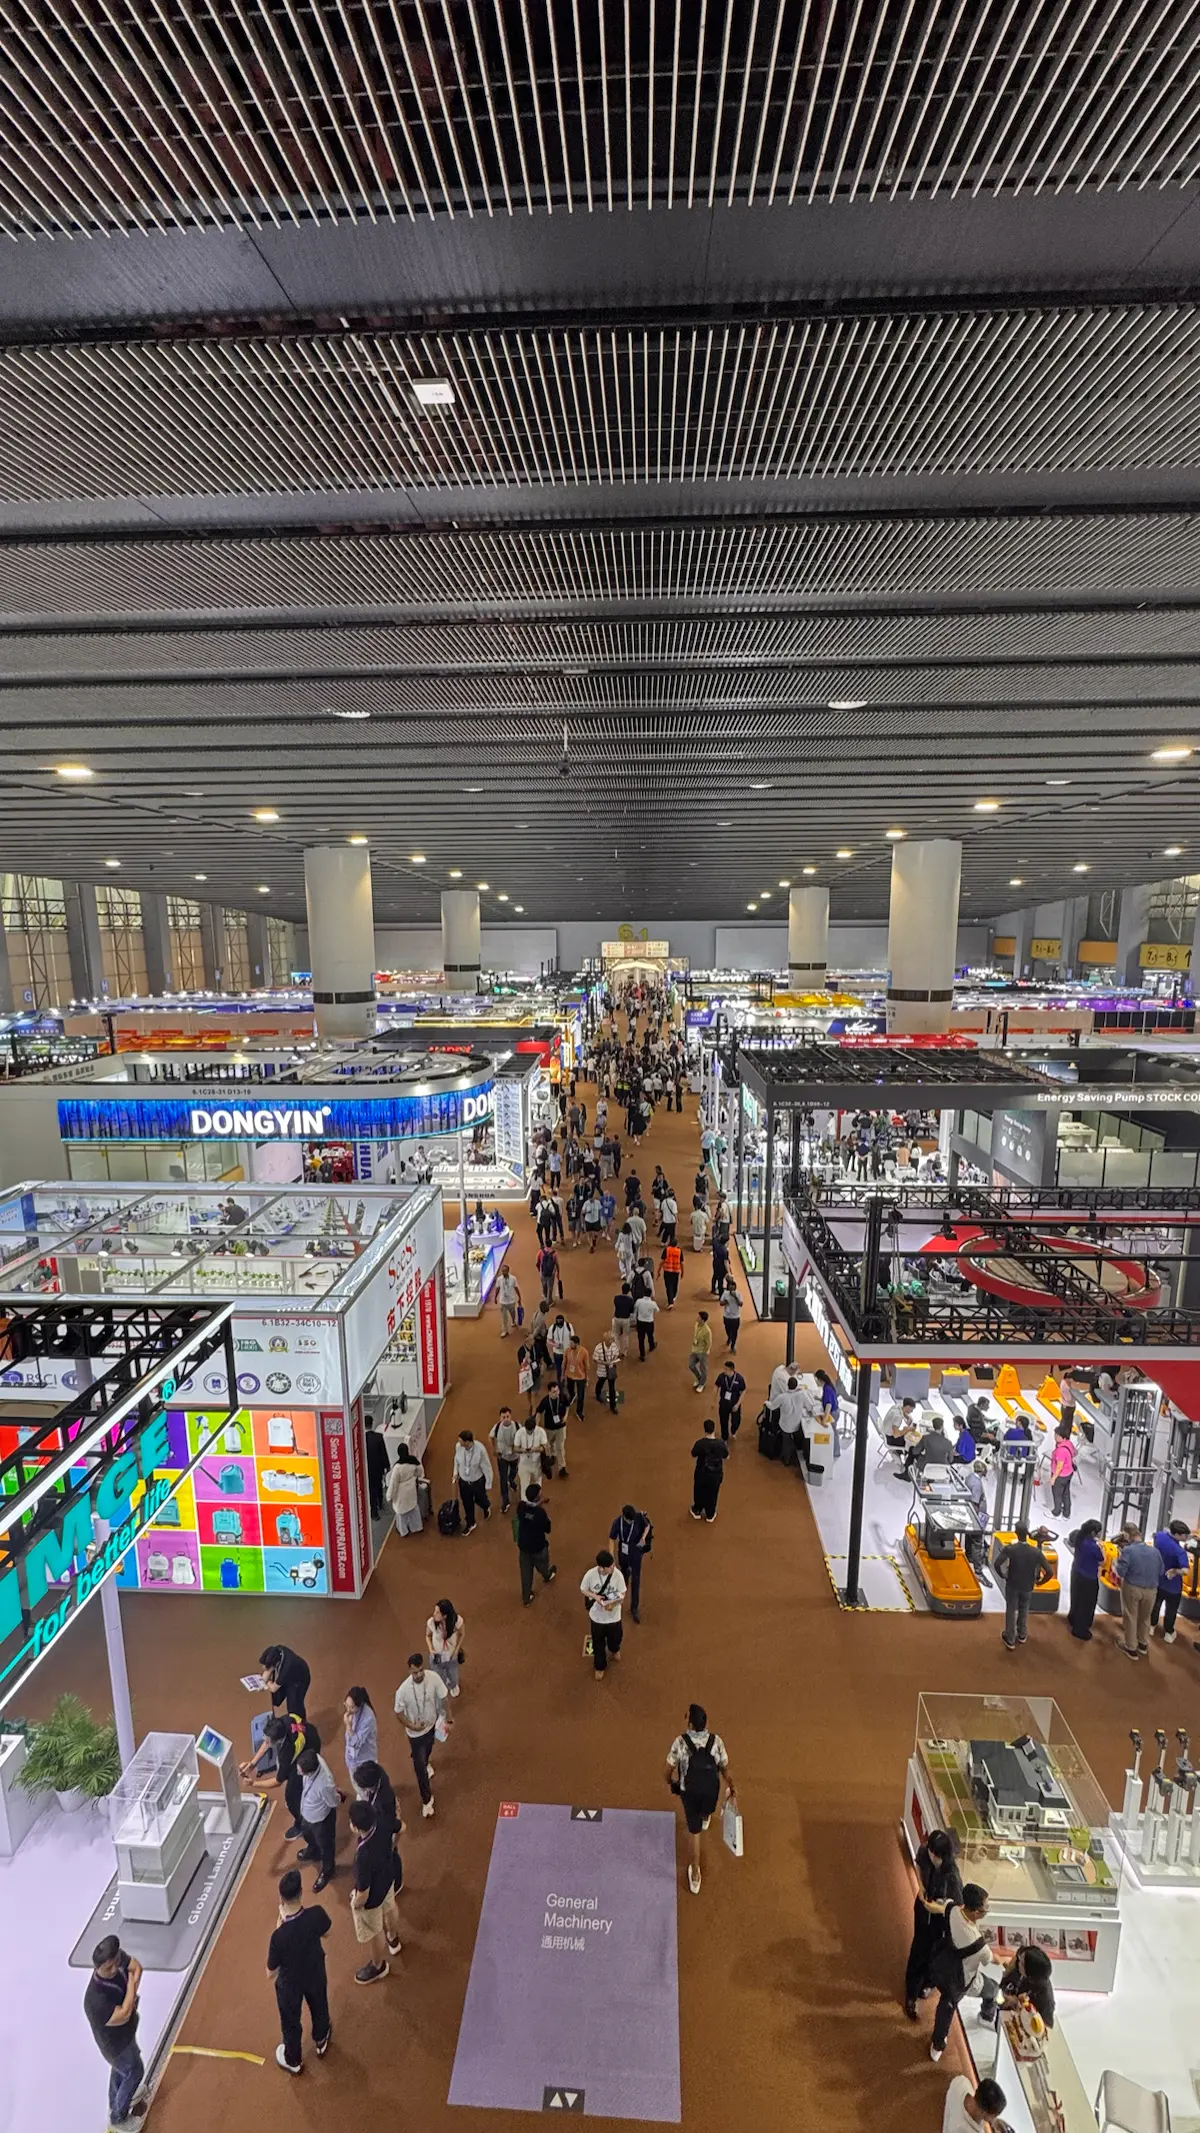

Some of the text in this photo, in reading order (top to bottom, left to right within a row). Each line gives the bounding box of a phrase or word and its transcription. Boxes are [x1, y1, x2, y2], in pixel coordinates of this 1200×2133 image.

[618, 924, 648, 940] 6.1
[24, 991, 32, 1001] G
[1037, 1093, 1075, 1104] Energy
[1077, 1092, 1112, 1104] Saving
[1114, 1093, 1145, 1104] Pump
[1146, 1093, 1182, 1102] STOCK
[191, 1109, 324, 1134] DONGYIN
[330, 1437, 338, 1459] Since
[331, 1461, 341, 1479] 1978
[33, 1477, 172, 1659] for better life
[188, 1837, 234, 1925] Global Launch
[546, 1893, 598, 1910] General
[543, 1912, 613, 1934] Machinery
[540, 1935, 585, 1951] 通用机械
